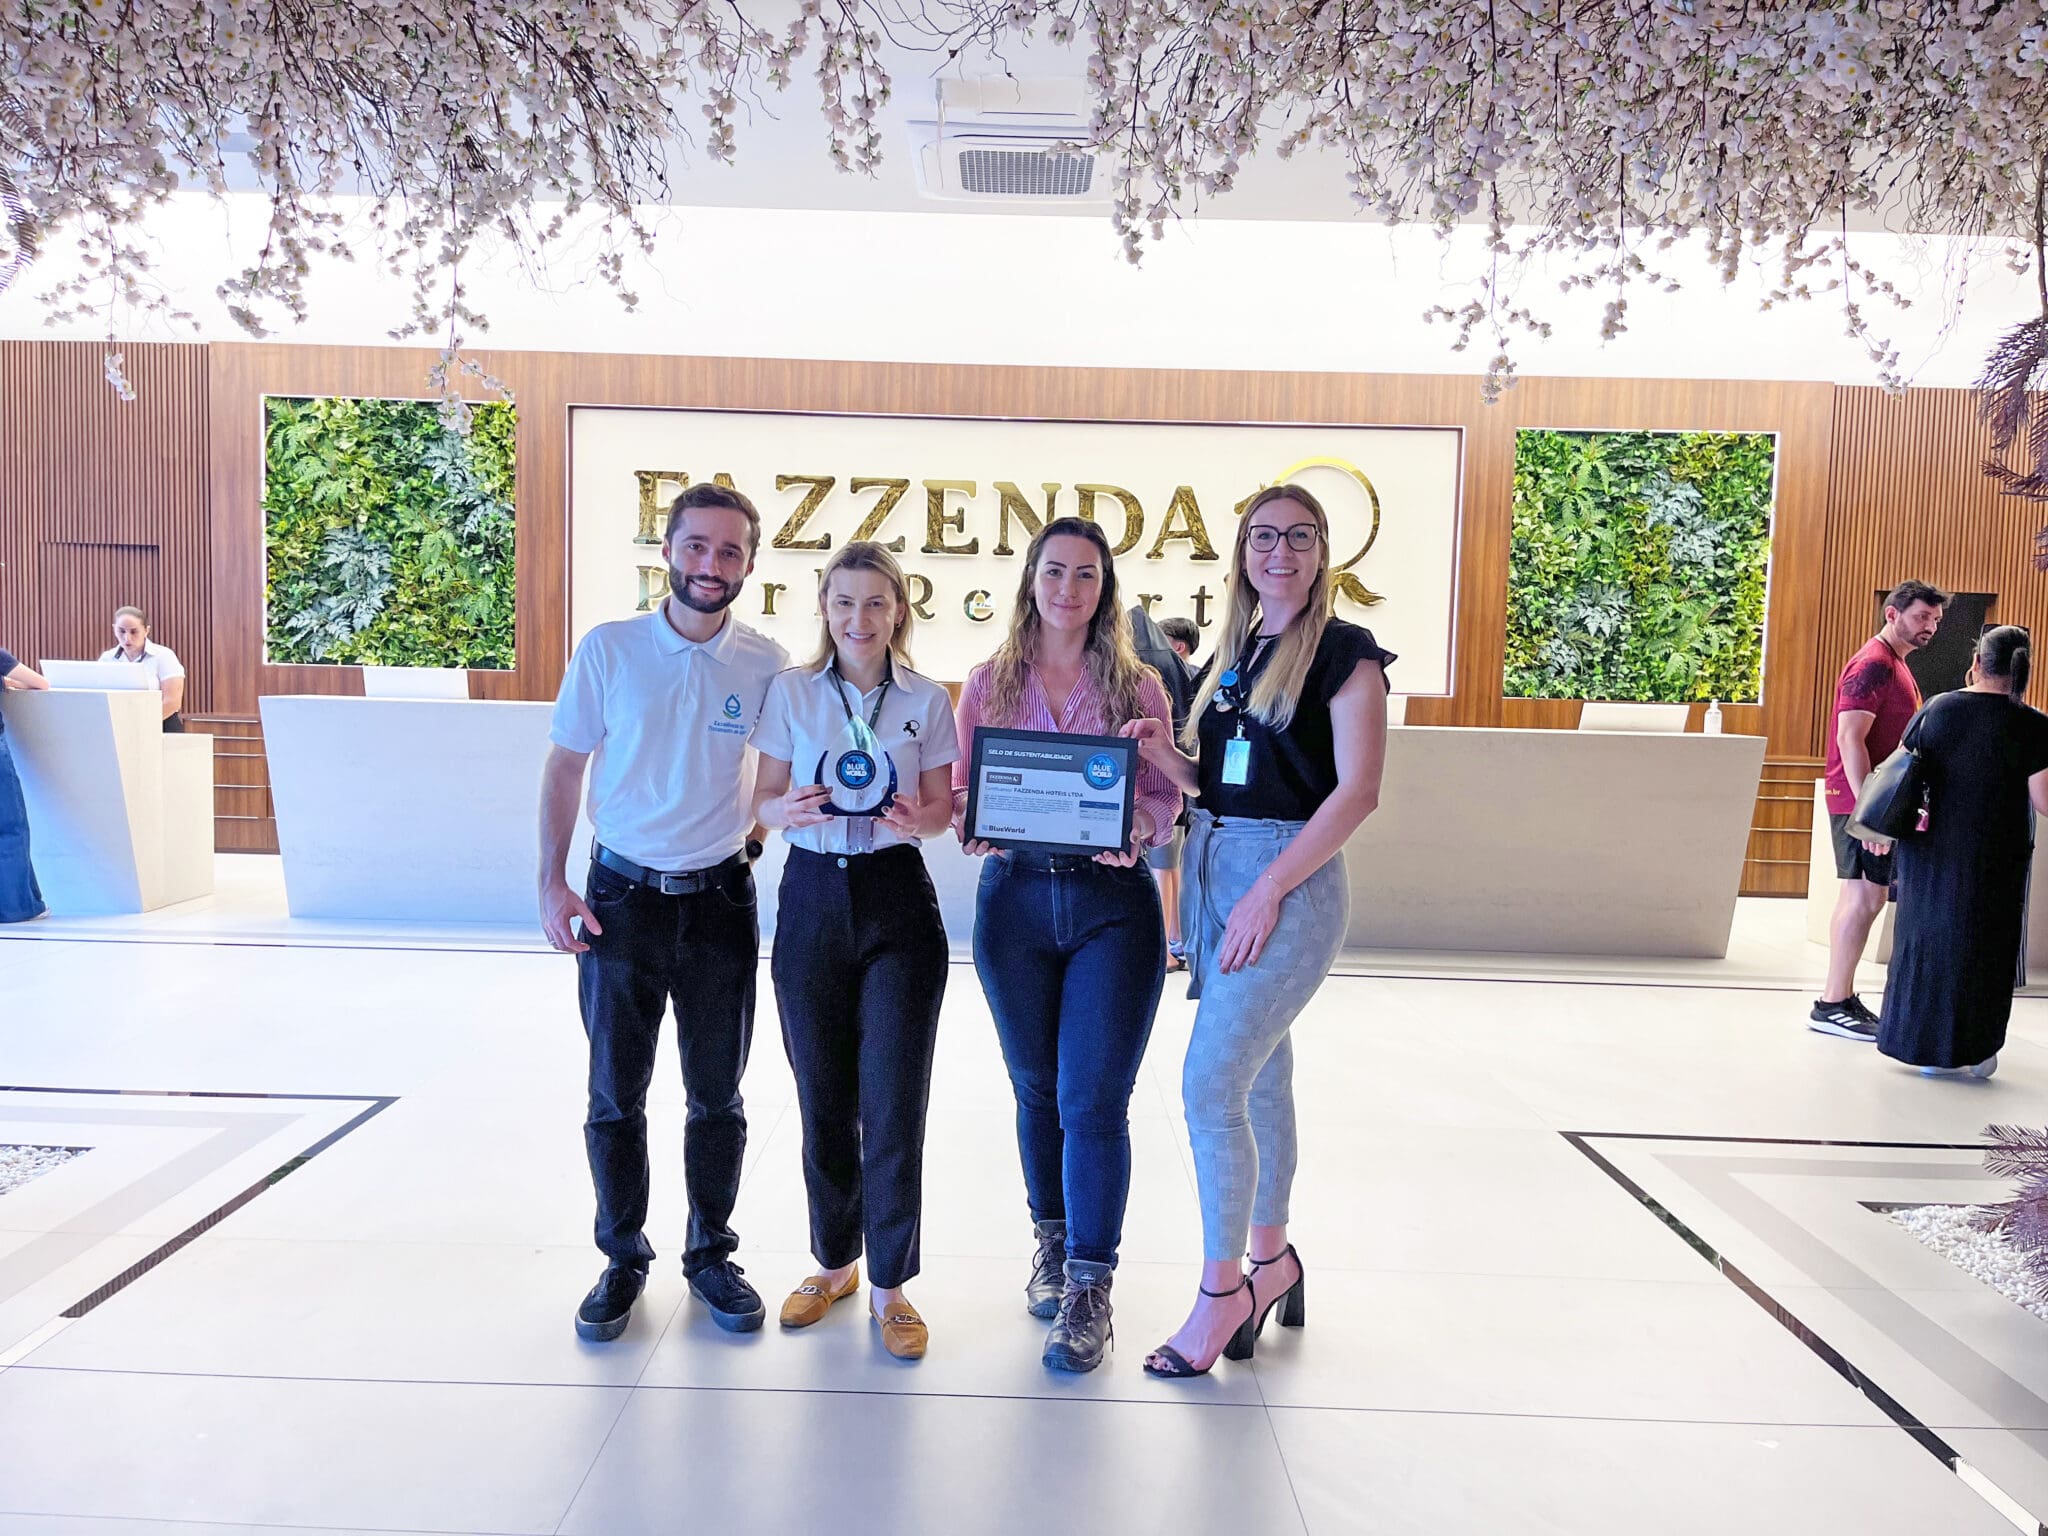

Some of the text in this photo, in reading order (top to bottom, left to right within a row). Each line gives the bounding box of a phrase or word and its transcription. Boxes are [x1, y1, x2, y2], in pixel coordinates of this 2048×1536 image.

[633, 469, 1219, 560] FZZENDA
[1013, 751, 1073, 760] SUSTENTABILIDADE
[988, 825, 1026, 834] BlueWorld
